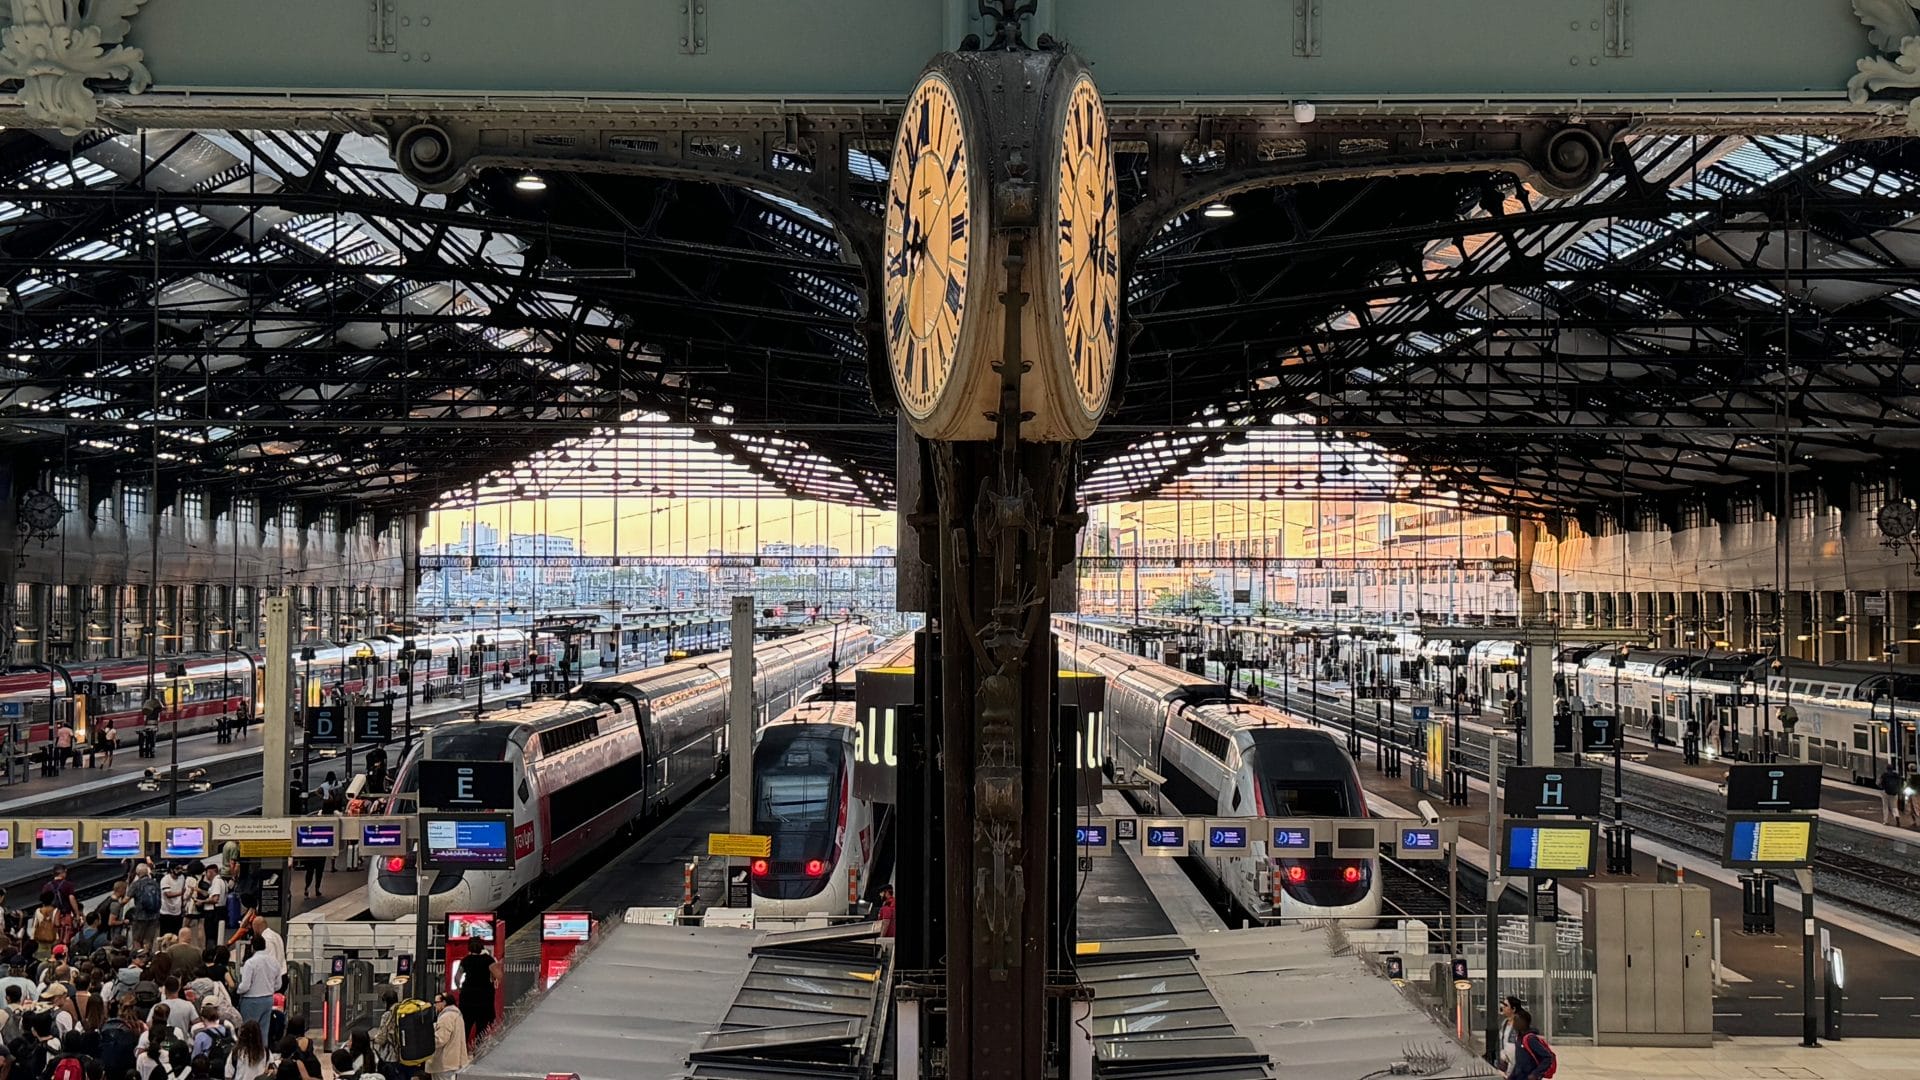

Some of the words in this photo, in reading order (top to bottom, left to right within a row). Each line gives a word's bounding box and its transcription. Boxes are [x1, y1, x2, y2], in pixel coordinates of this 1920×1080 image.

[82, 685, 90, 694] R
[99, 684, 107, 694] R
[317, 718, 333, 735] D
[367, 718, 379, 735] E
[1594, 728, 1606, 745] J
[458, 776, 474, 798] E
[1542, 782, 1563, 805] H
